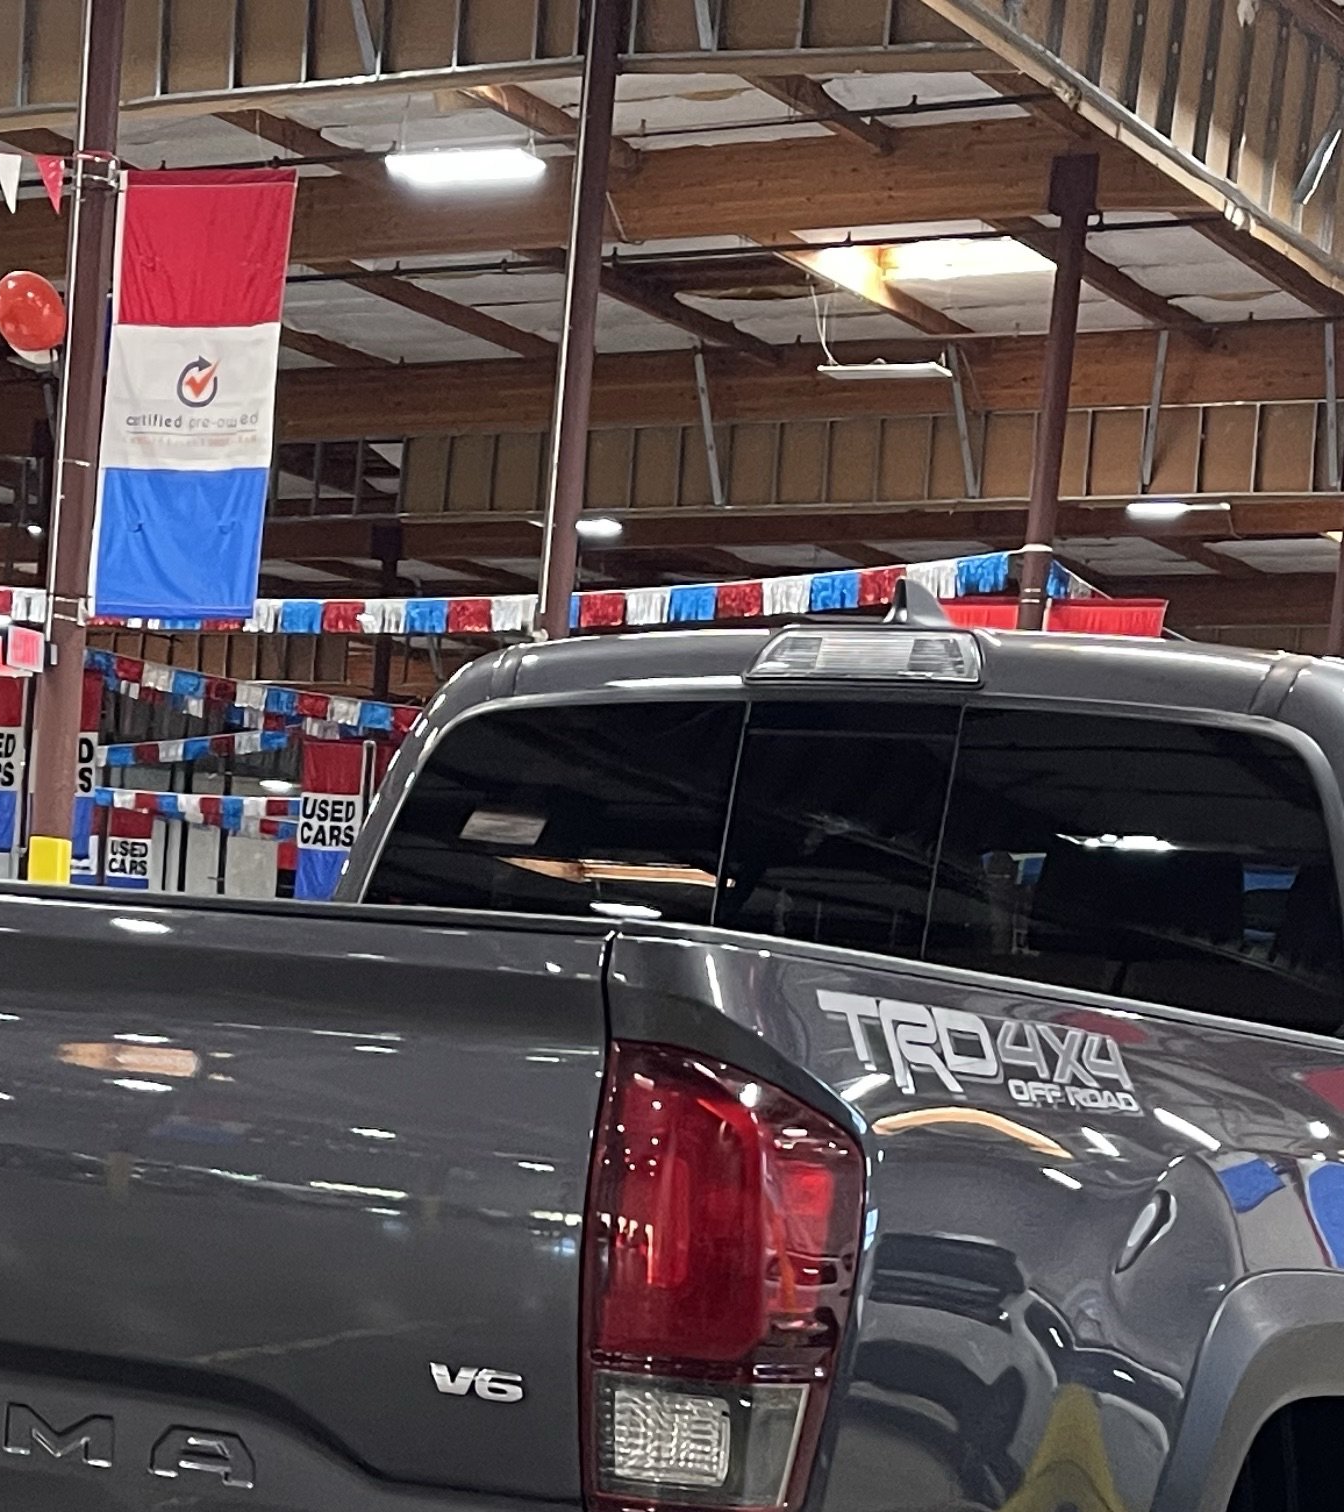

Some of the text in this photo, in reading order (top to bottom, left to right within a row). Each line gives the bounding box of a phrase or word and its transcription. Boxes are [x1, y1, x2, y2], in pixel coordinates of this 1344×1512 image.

[301, 796, 356, 823] USED
[300, 822, 355, 847] CARS
[110, 840, 148, 858] USED
[108, 858, 148, 877] CARS
[816, 989, 1001, 1094] TRD
[1008, 1079, 1140, 1112] OFF ROAD
[429, 1361, 524, 1402] V6
